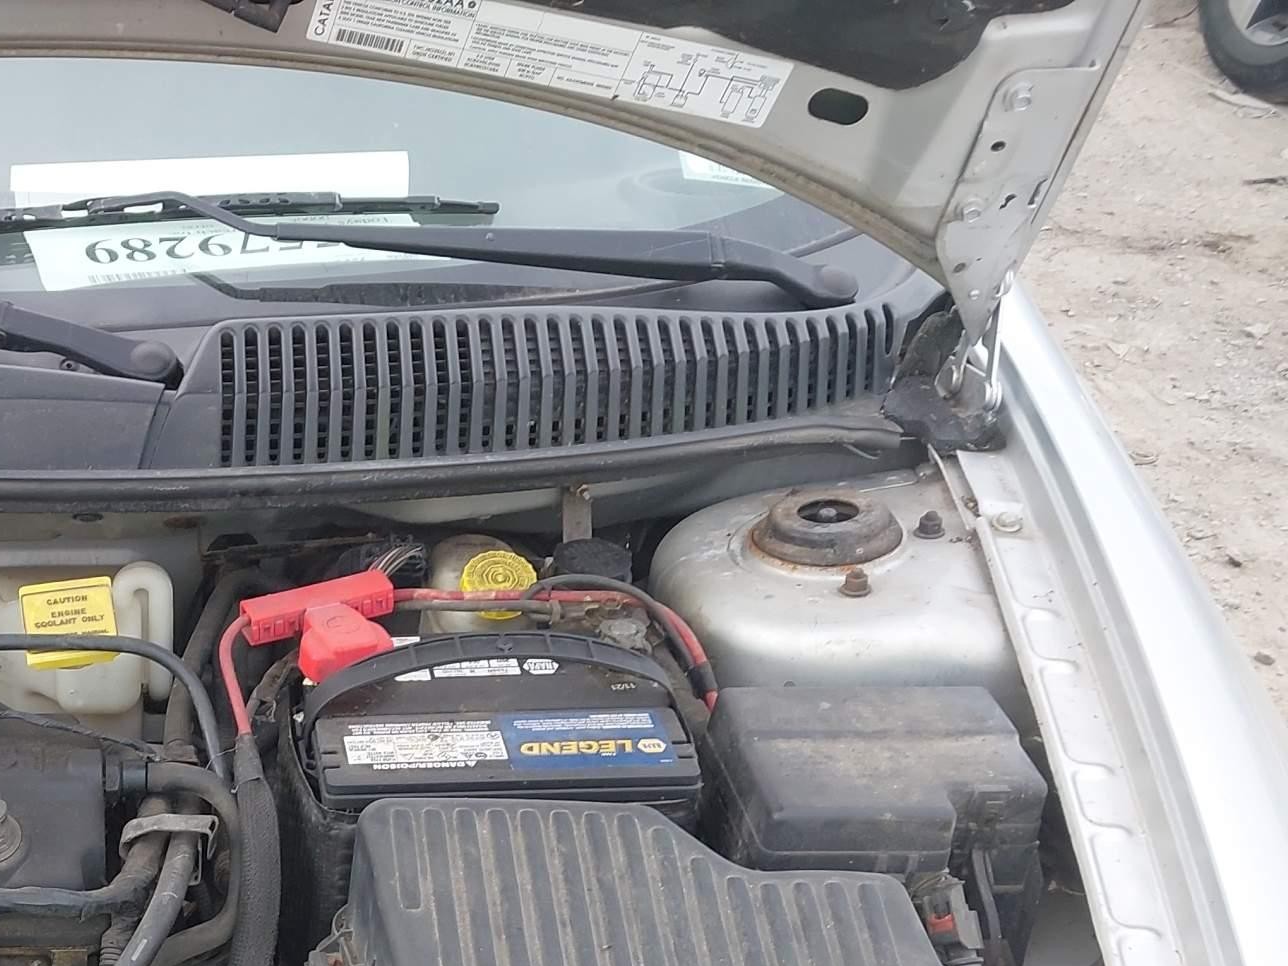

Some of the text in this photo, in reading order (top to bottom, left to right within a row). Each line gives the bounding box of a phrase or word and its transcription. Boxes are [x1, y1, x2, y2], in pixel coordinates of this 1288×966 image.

[46, 594, 88, 606] CAUTION
[51, 608, 87, 618] ENGINE
[34, 614, 105, 629] COOLANT ONLY
[520, 740, 633, 756] LEGEND
[373, 761, 466, 770] DANGER/POISON
